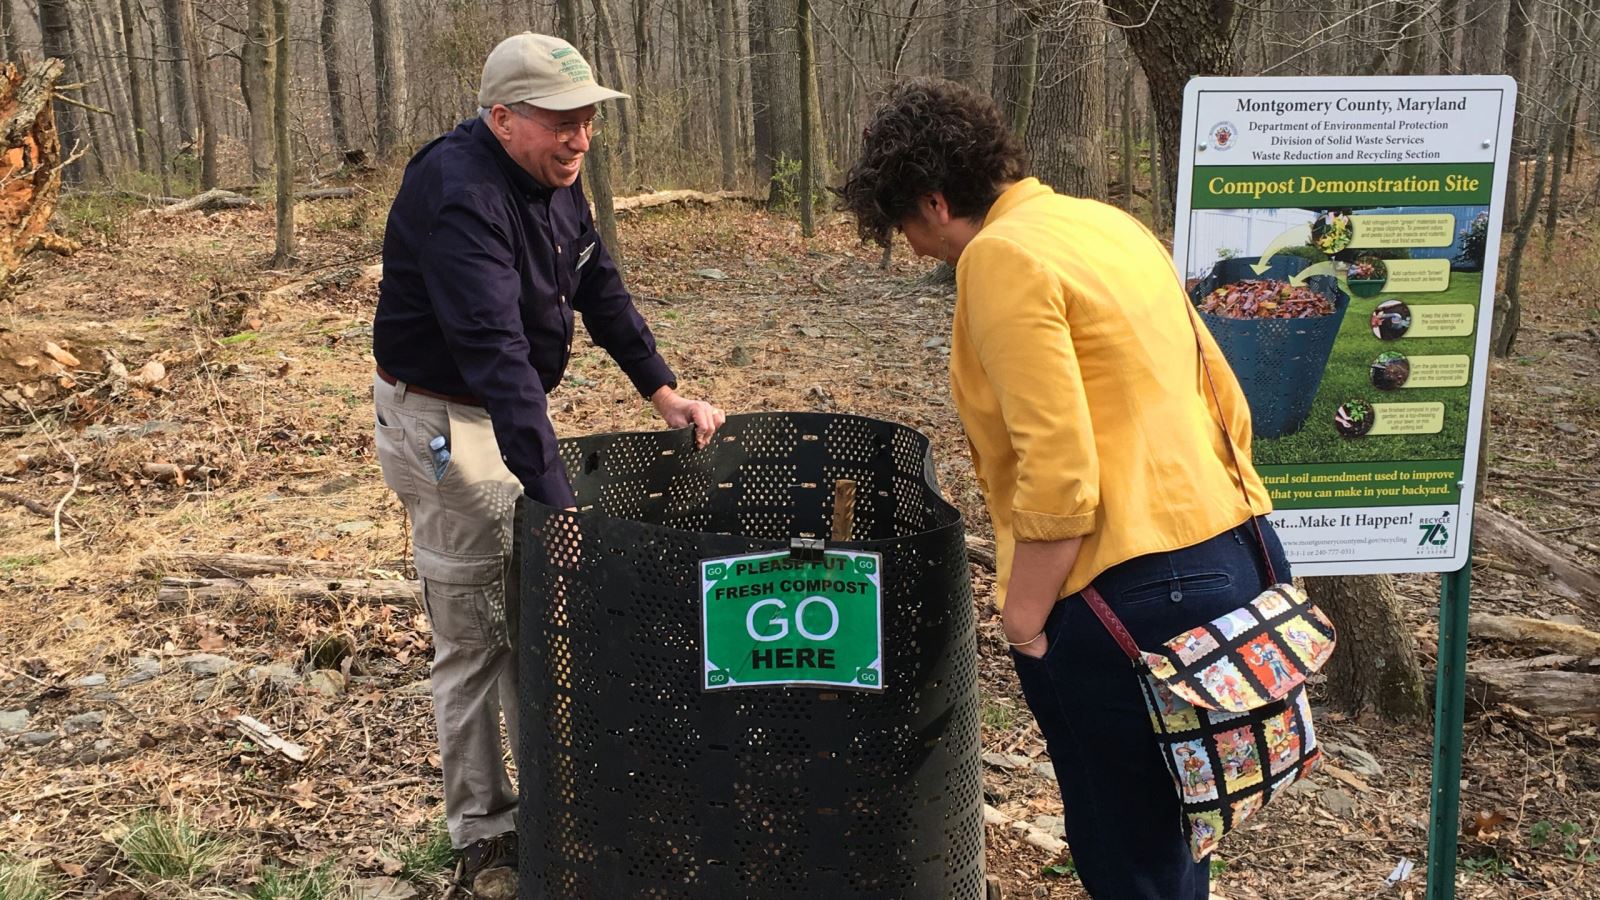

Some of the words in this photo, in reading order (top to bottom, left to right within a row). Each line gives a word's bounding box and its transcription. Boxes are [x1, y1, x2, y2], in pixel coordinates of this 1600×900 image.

[1236, 98, 1332, 116] Montgomery
[1336, 97, 1393, 115] County,
[1397, 97, 1467, 114] Maryland
[1249, 121, 1308, 134] Department
[1310, 120, 1322, 131] of
[1323, 120, 1396, 131] Environmental
[1398, 120, 1449, 130] Protection
[1271, 136, 1312, 146] Division
[1314, 135, 1326, 146] of
[1327, 135, 1352, 146] Solid
[1355, 135, 1384, 145] Waste
[1385, 134, 1425, 145] Services
[1252, 151, 1281, 160] Waste
[1283, 150, 1333, 160] Reduction
[1335, 150, 1354, 160] and
[1356, 149, 1403, 161] Recycling
[1405, 149, 1440, 160] Section
[1208, 176, 1295, 198] Compost
[1300, 174, 1440, 194] Demonstration
[1445, 174, 1480, 192] Site
[1291, 472, 1309, 484] soil
[1311, 472, 1372, 482] amendment
[1375, 470, 1397, 482] used
[1399, 472, 1410, 481] to
[1412, 470, 1454, 482] improve
[1271, 489, 1291, 499] that
[1293, 490, 1312, 501] you
[1314, 489, 1332, 498] can
[1334, 486, 1362, 497] make
[1364, 486, 1374, 496] in
[1376, 487, 1400, 498] your
[1402, 484, 1450, 498] backyard.
[1341, 514, 1351, 527] It
[1355, 512, 1413, 530] Happen!
[859, 560, 873, 568] GO
[708, 567, 722, 576] GO
[715, 582, 774, 600] FRESH
[780, 580, 868, 594] COMPOST
[746, 596, 840, 642] GO
[752, 648, 836, 670] HERE
[710, 674, 724, 682] GO
[861, 673, 876, 682] GO
